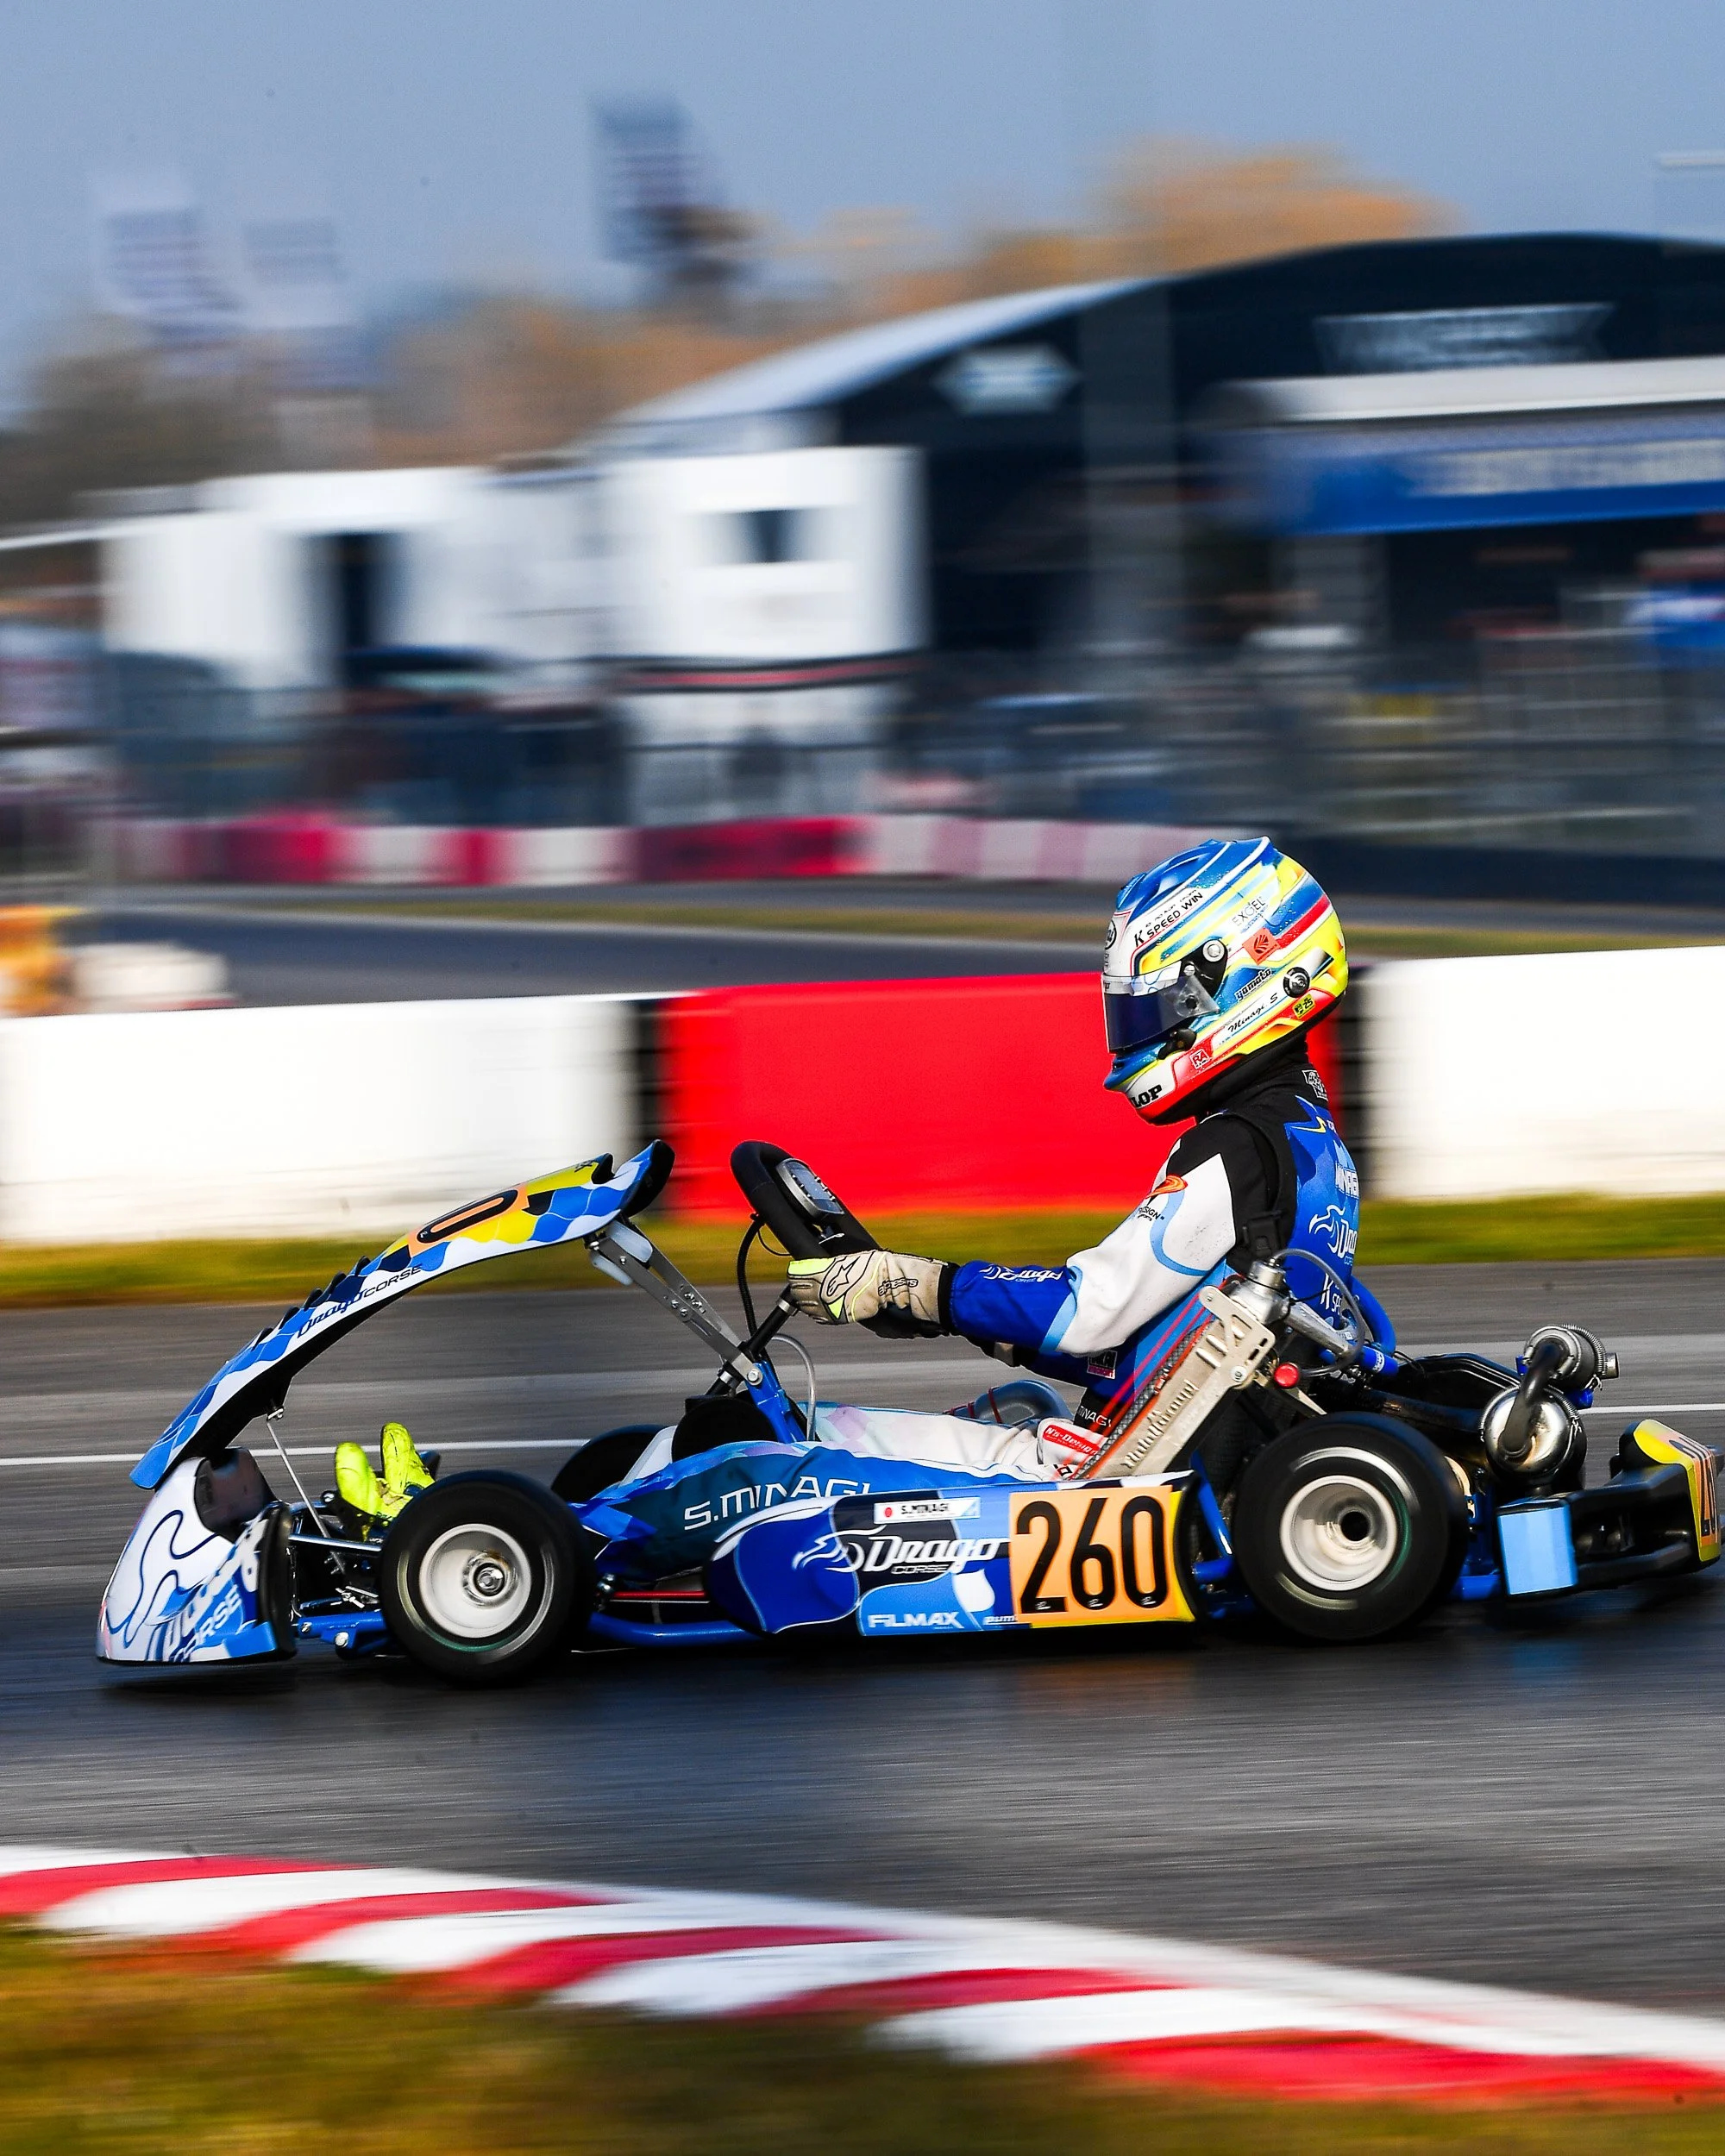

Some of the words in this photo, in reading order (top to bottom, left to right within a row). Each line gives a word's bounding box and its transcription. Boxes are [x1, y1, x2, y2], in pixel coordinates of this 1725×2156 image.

[1134, 930, 1145, 948] K
[1146, 910, 1181, 938] SPEED
[1181, 892, 1203, 910] WIN
[1236, 968, 1271, 1000] yamato
[363, 1263, 423, 1298] CORSE
[862, 1535, 1010, 1574] Drago
[891, 1563, 950, 1575] CORSE
[1016, 1495, 1170, 1614] 260
